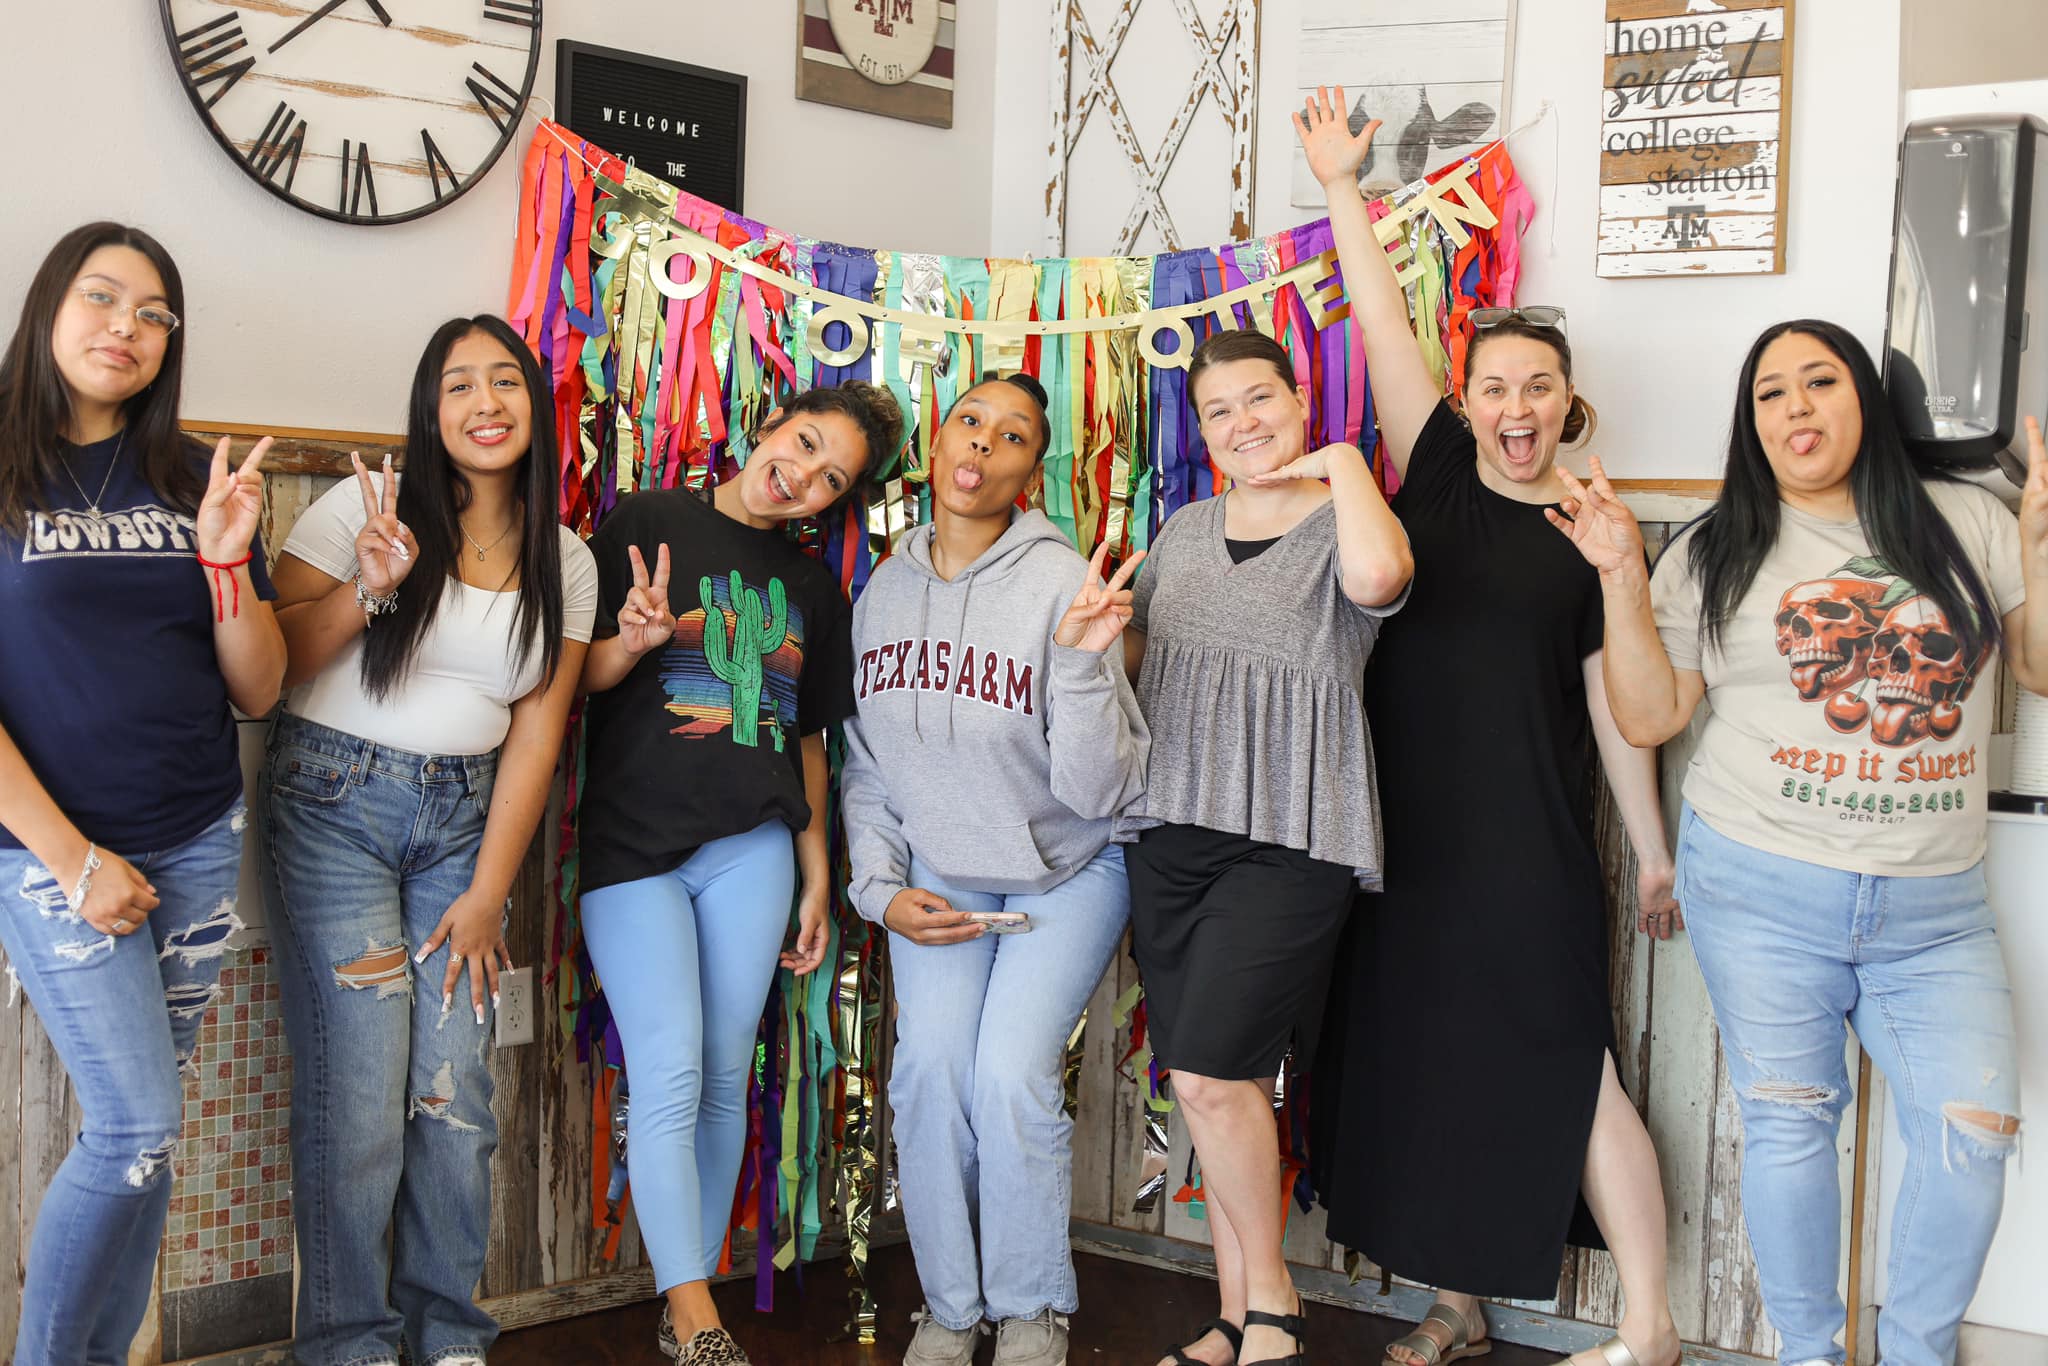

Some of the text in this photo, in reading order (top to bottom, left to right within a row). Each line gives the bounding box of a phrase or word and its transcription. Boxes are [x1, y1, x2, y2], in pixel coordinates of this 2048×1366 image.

[1613, 17, 1728, 57] home
[1608, 21, 1775, 118] sweet
[603, 106, 701, 138] WELCOME
[1607, 119, 1735, 162] college
[666, 161, 687, 178] THE
[1647, 163, 1773, 196] station
[858, 638, 1034, 716] TEXAS A&M
[1857, 748, 1884, 783] it
[1895, 744, 1976, 783] sweet
[1781, 777, 1965, 814] 331-443-2499
[1839, 812, 1906, 824] OPEN 24/7
